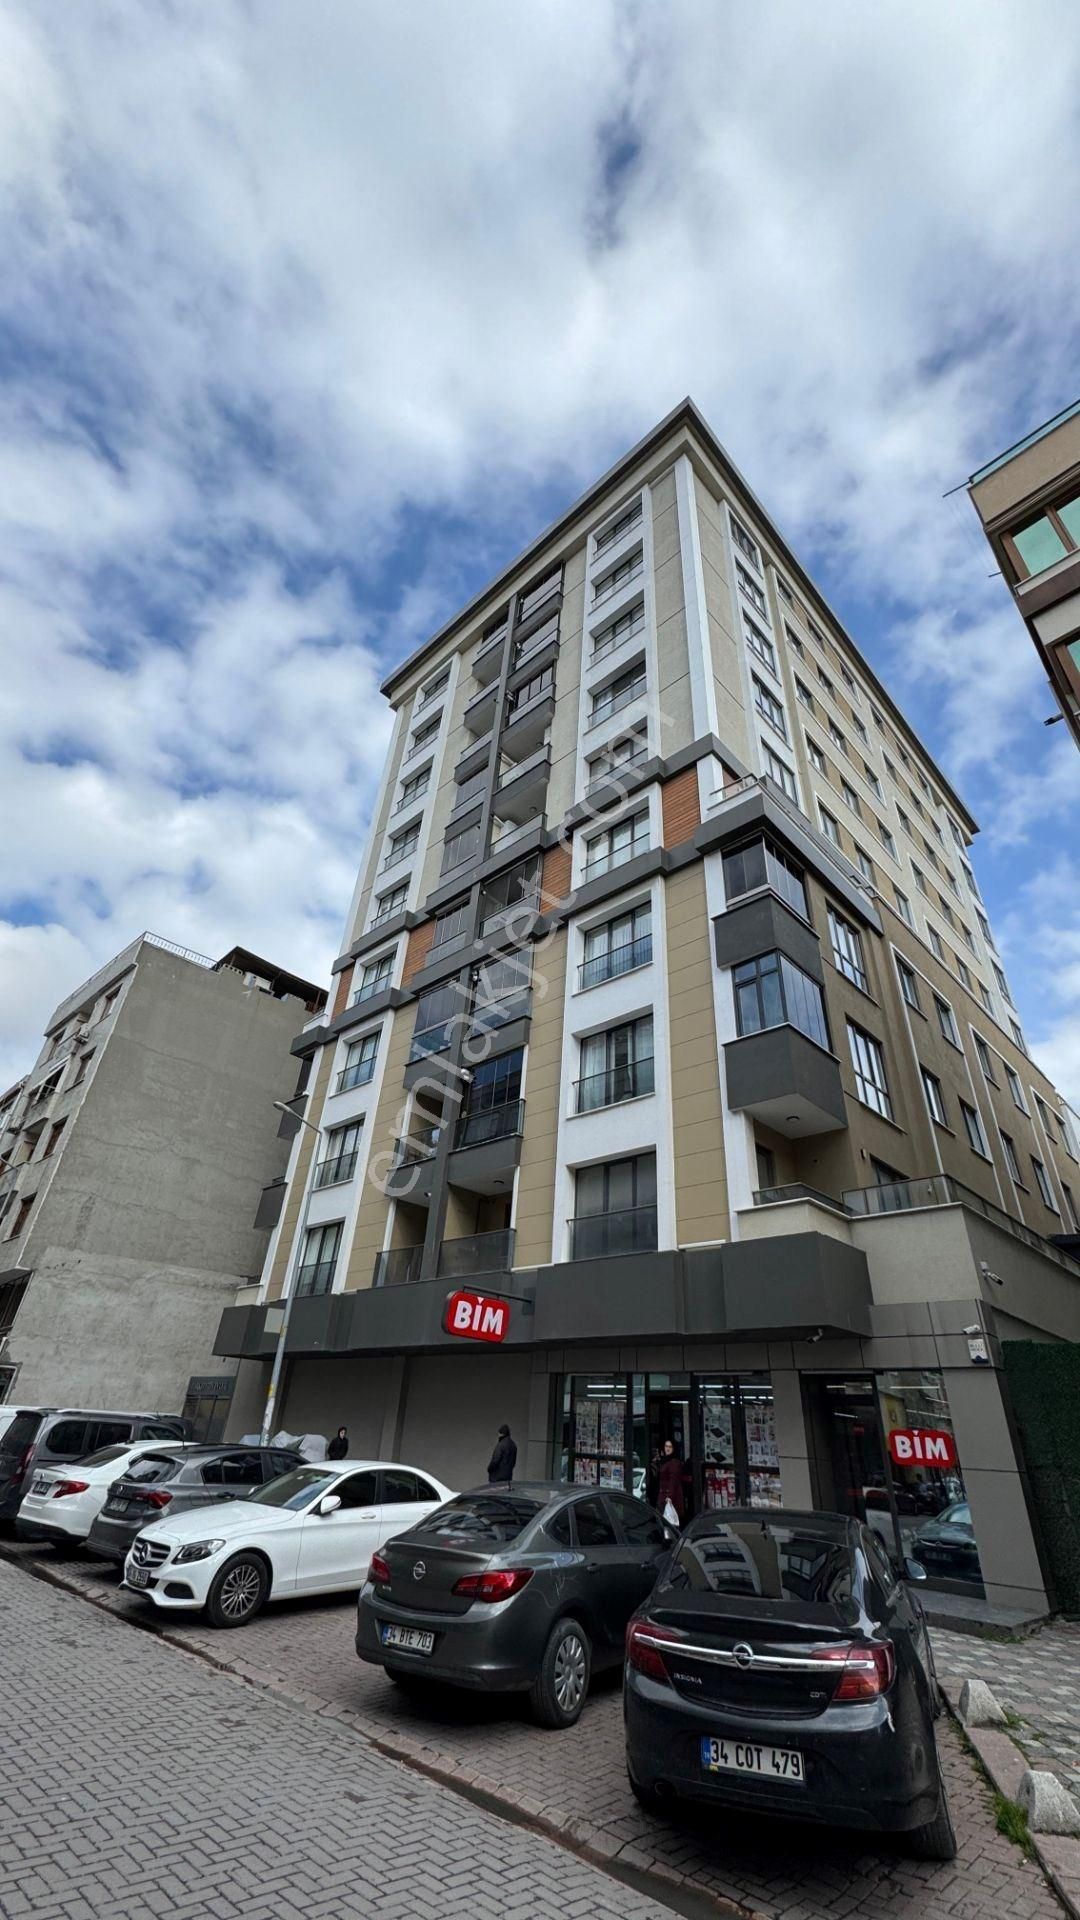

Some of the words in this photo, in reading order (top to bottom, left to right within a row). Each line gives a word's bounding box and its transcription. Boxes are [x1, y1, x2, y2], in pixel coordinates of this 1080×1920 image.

[453, 1296, 504, 1335] BİM
[894, 1430, 950, 1461] BİM
[400, 1629, 415, 1645] BTE
[417, 1632, 432, 1649] 703
[711, 1741, 728, 1764] 34
[735, 1745, 762, 1770] COT
[772, 1751, 800, 1776] 479
